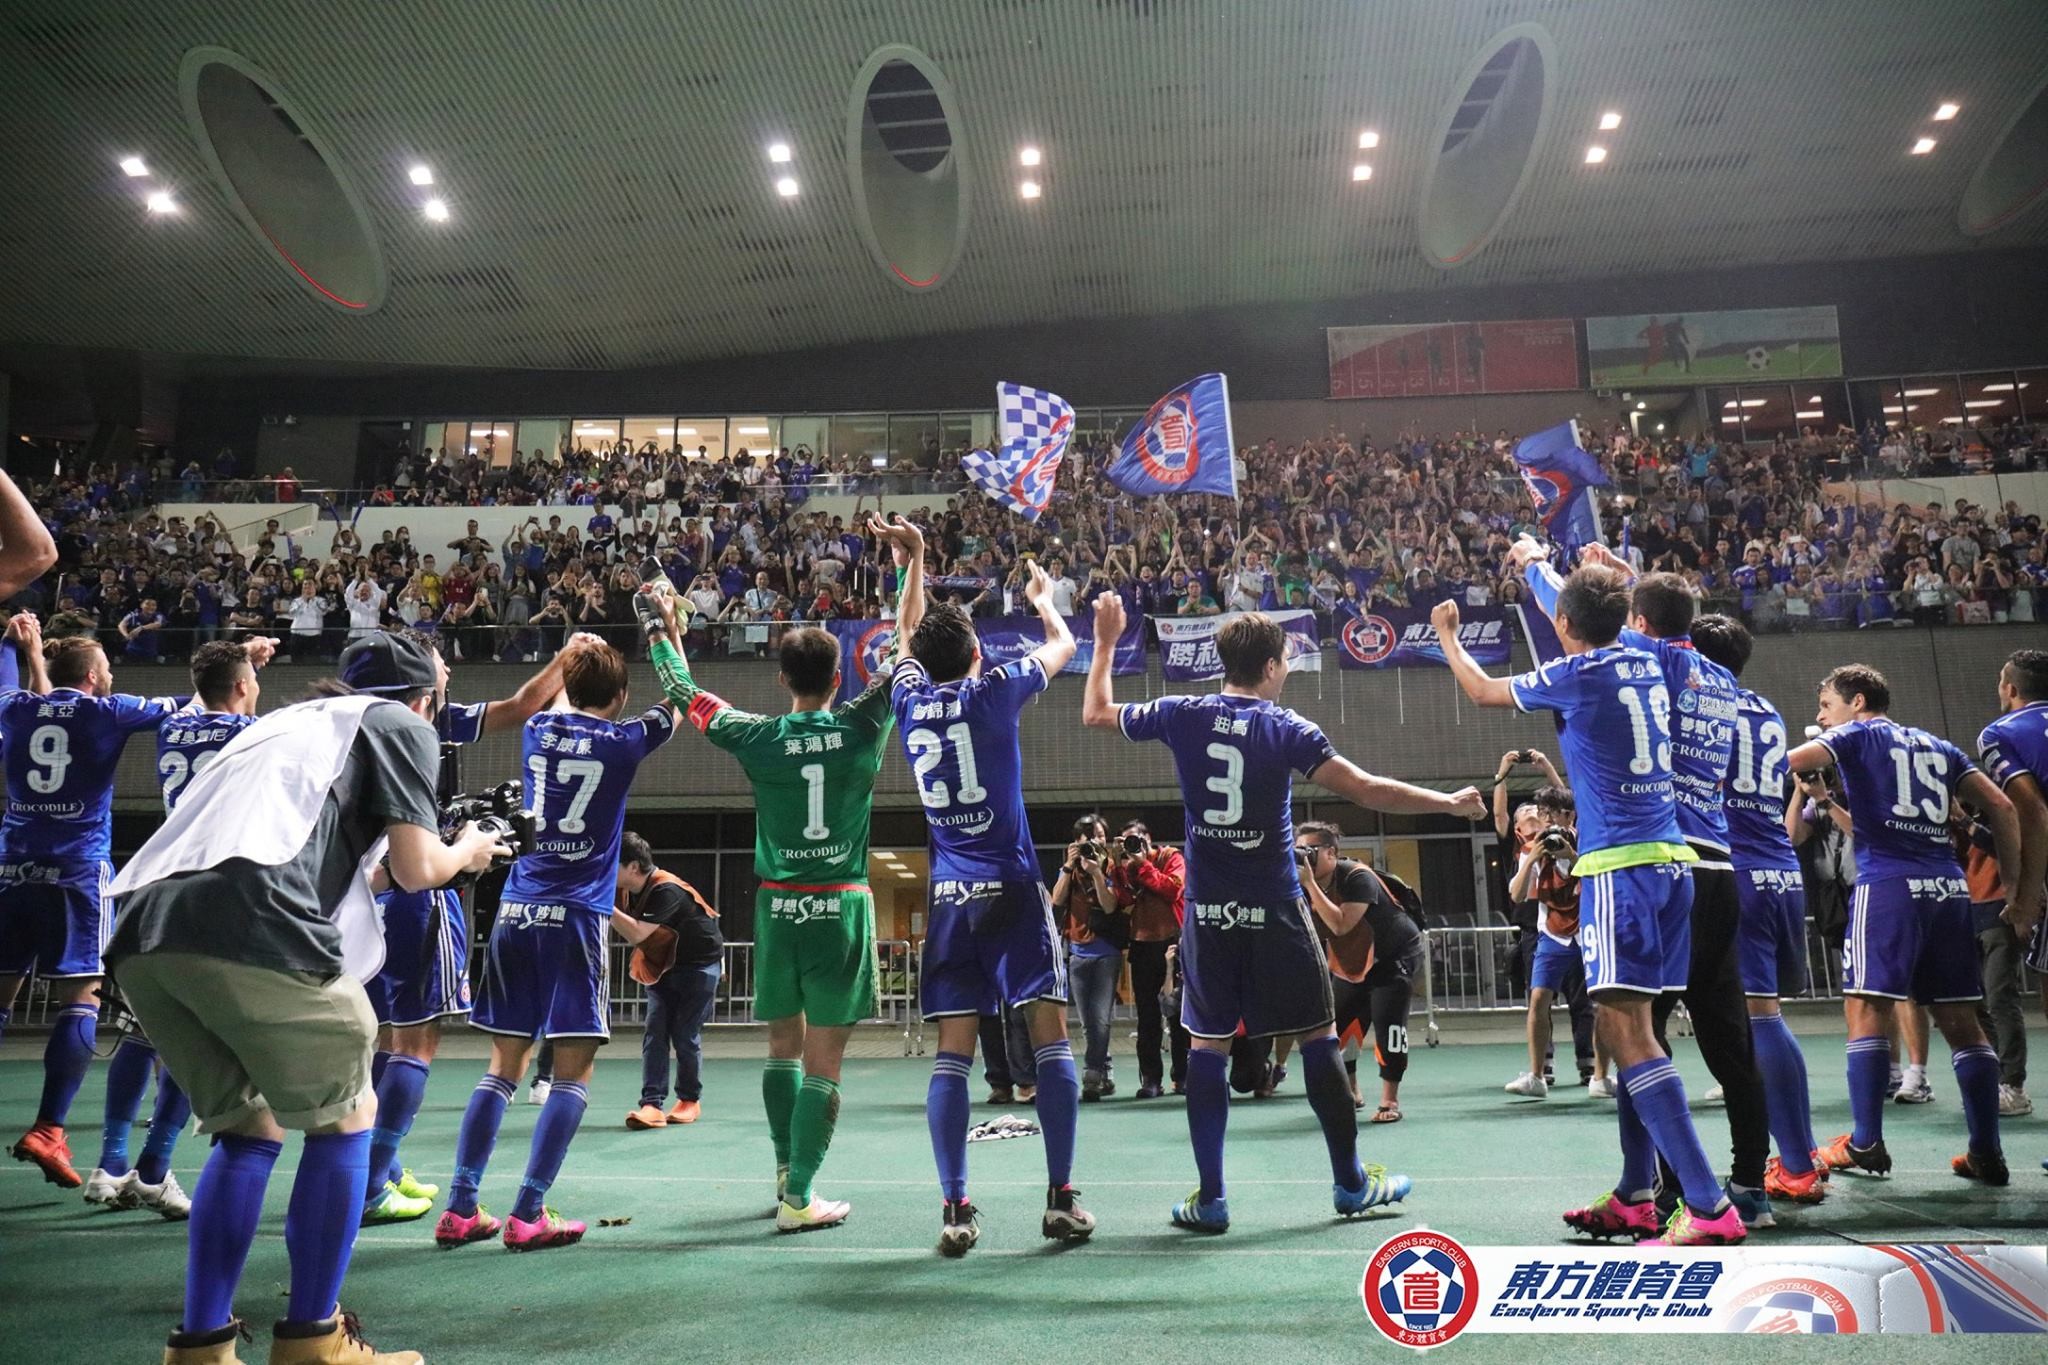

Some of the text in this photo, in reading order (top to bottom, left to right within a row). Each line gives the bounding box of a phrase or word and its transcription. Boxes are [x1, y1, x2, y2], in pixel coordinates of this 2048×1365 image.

[1401, 620, 1502, 641] 東方育會
[26, 724, 72, 794] 9
[784, 732, 844, 756] 葉鴻輝
[1212, 714, 1249, 737] 迪高
[1618, 684, 1671, 774] 19
[1732, 715, 1787, 799] 12
[528, 754, 605, 834] 17
[907, 721, 988, 808] 21
[1203, 742, 1244, 825] 3
[1889, 747, 1949, 824] 15
[11, 801, 78, 813] CROCODILE
[801, 763, 830, 840] 1
[1192, 824, 1258, 839] CROCODILE
[1885, 818, 1947, 835] CROCODILE
[1387, 1024, 1409, 1054] 03
